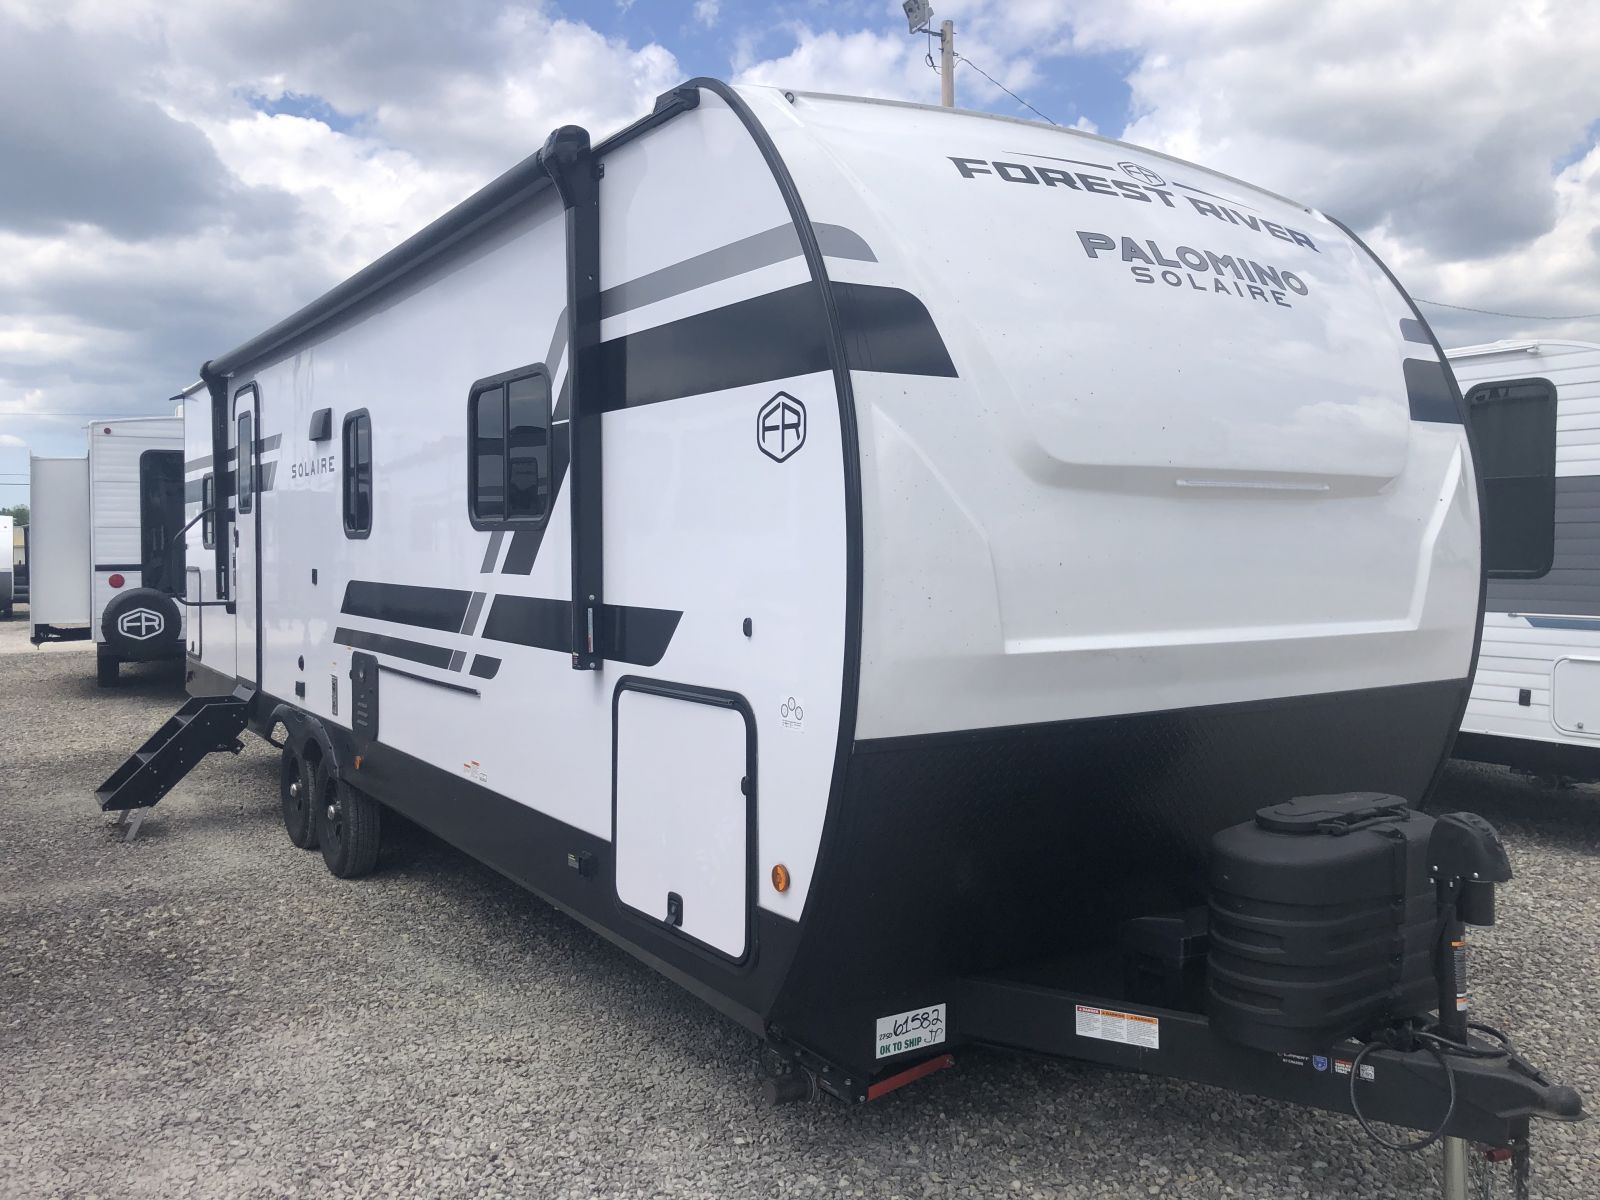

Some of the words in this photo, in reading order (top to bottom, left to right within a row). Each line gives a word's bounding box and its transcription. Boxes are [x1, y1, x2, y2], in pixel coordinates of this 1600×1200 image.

[946, 156, 1176, 209] FOREST
[1183, 195, 1321, 254] RIVER
[1076, 231, 1309, 296] PALOMINO
[1131, 266, 1293, 308] SOLAIRE
[291, 455, 335, 479] SOLAIRE
[893, 1008, 943, 1037] 61582
[880, 1043, 891, 1056] OK
[893, 1041, 902, 1052] TO
[904, 1036, 922, 1050] SHIP
